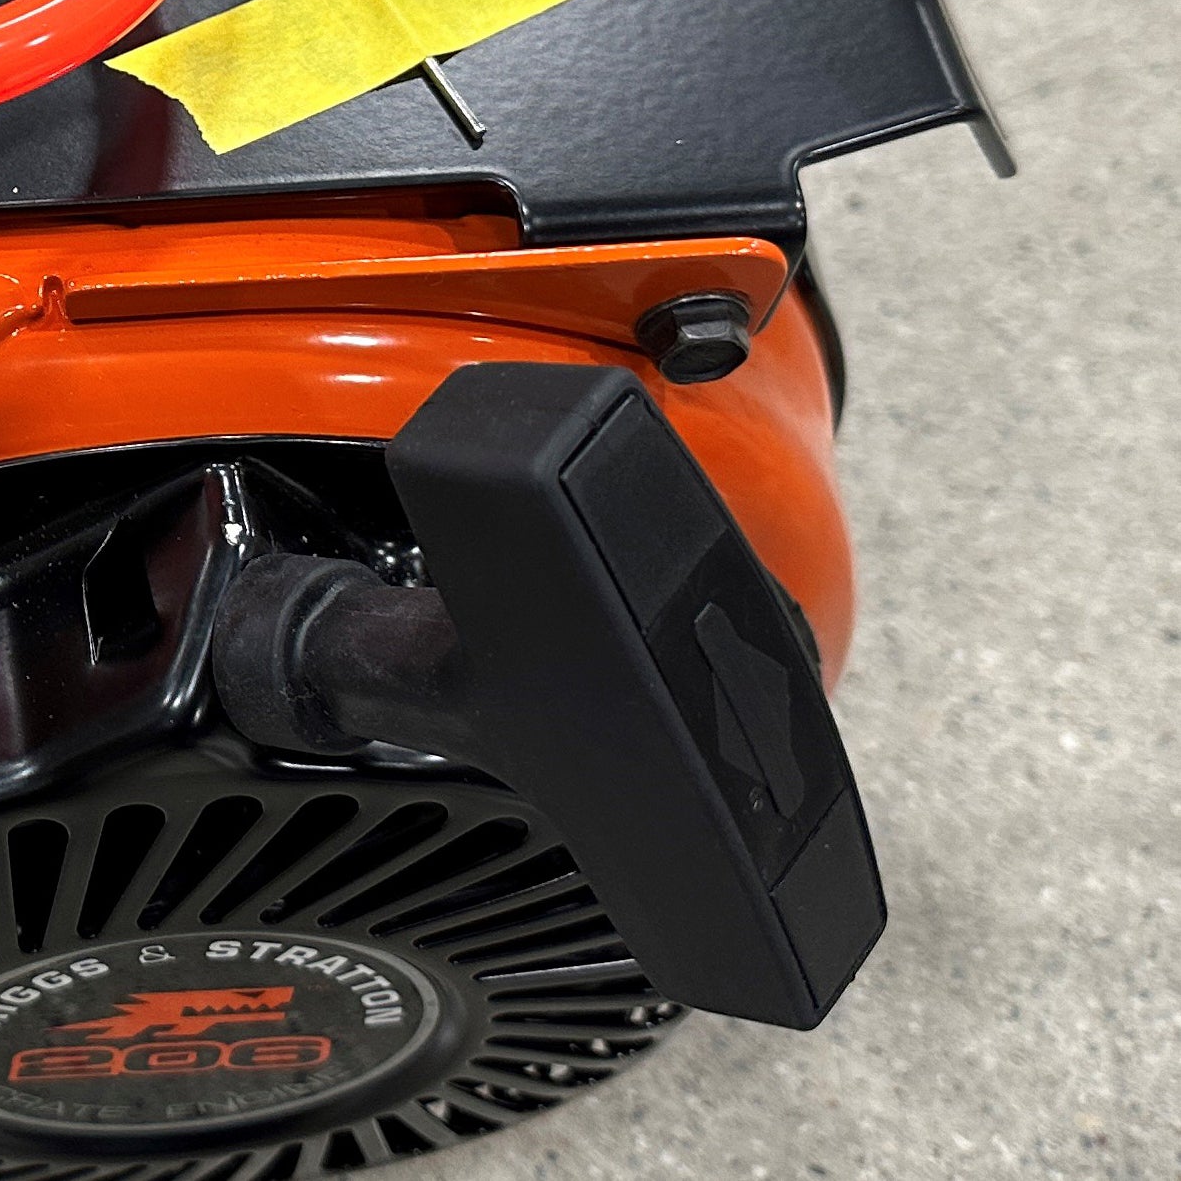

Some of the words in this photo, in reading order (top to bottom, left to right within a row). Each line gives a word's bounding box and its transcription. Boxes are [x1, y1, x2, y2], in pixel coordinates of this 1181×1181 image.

[138, 945, 176, 964] &
[205, 940, 403, 1026] STRATTON
[8, 1036, 332, 1081] 206
